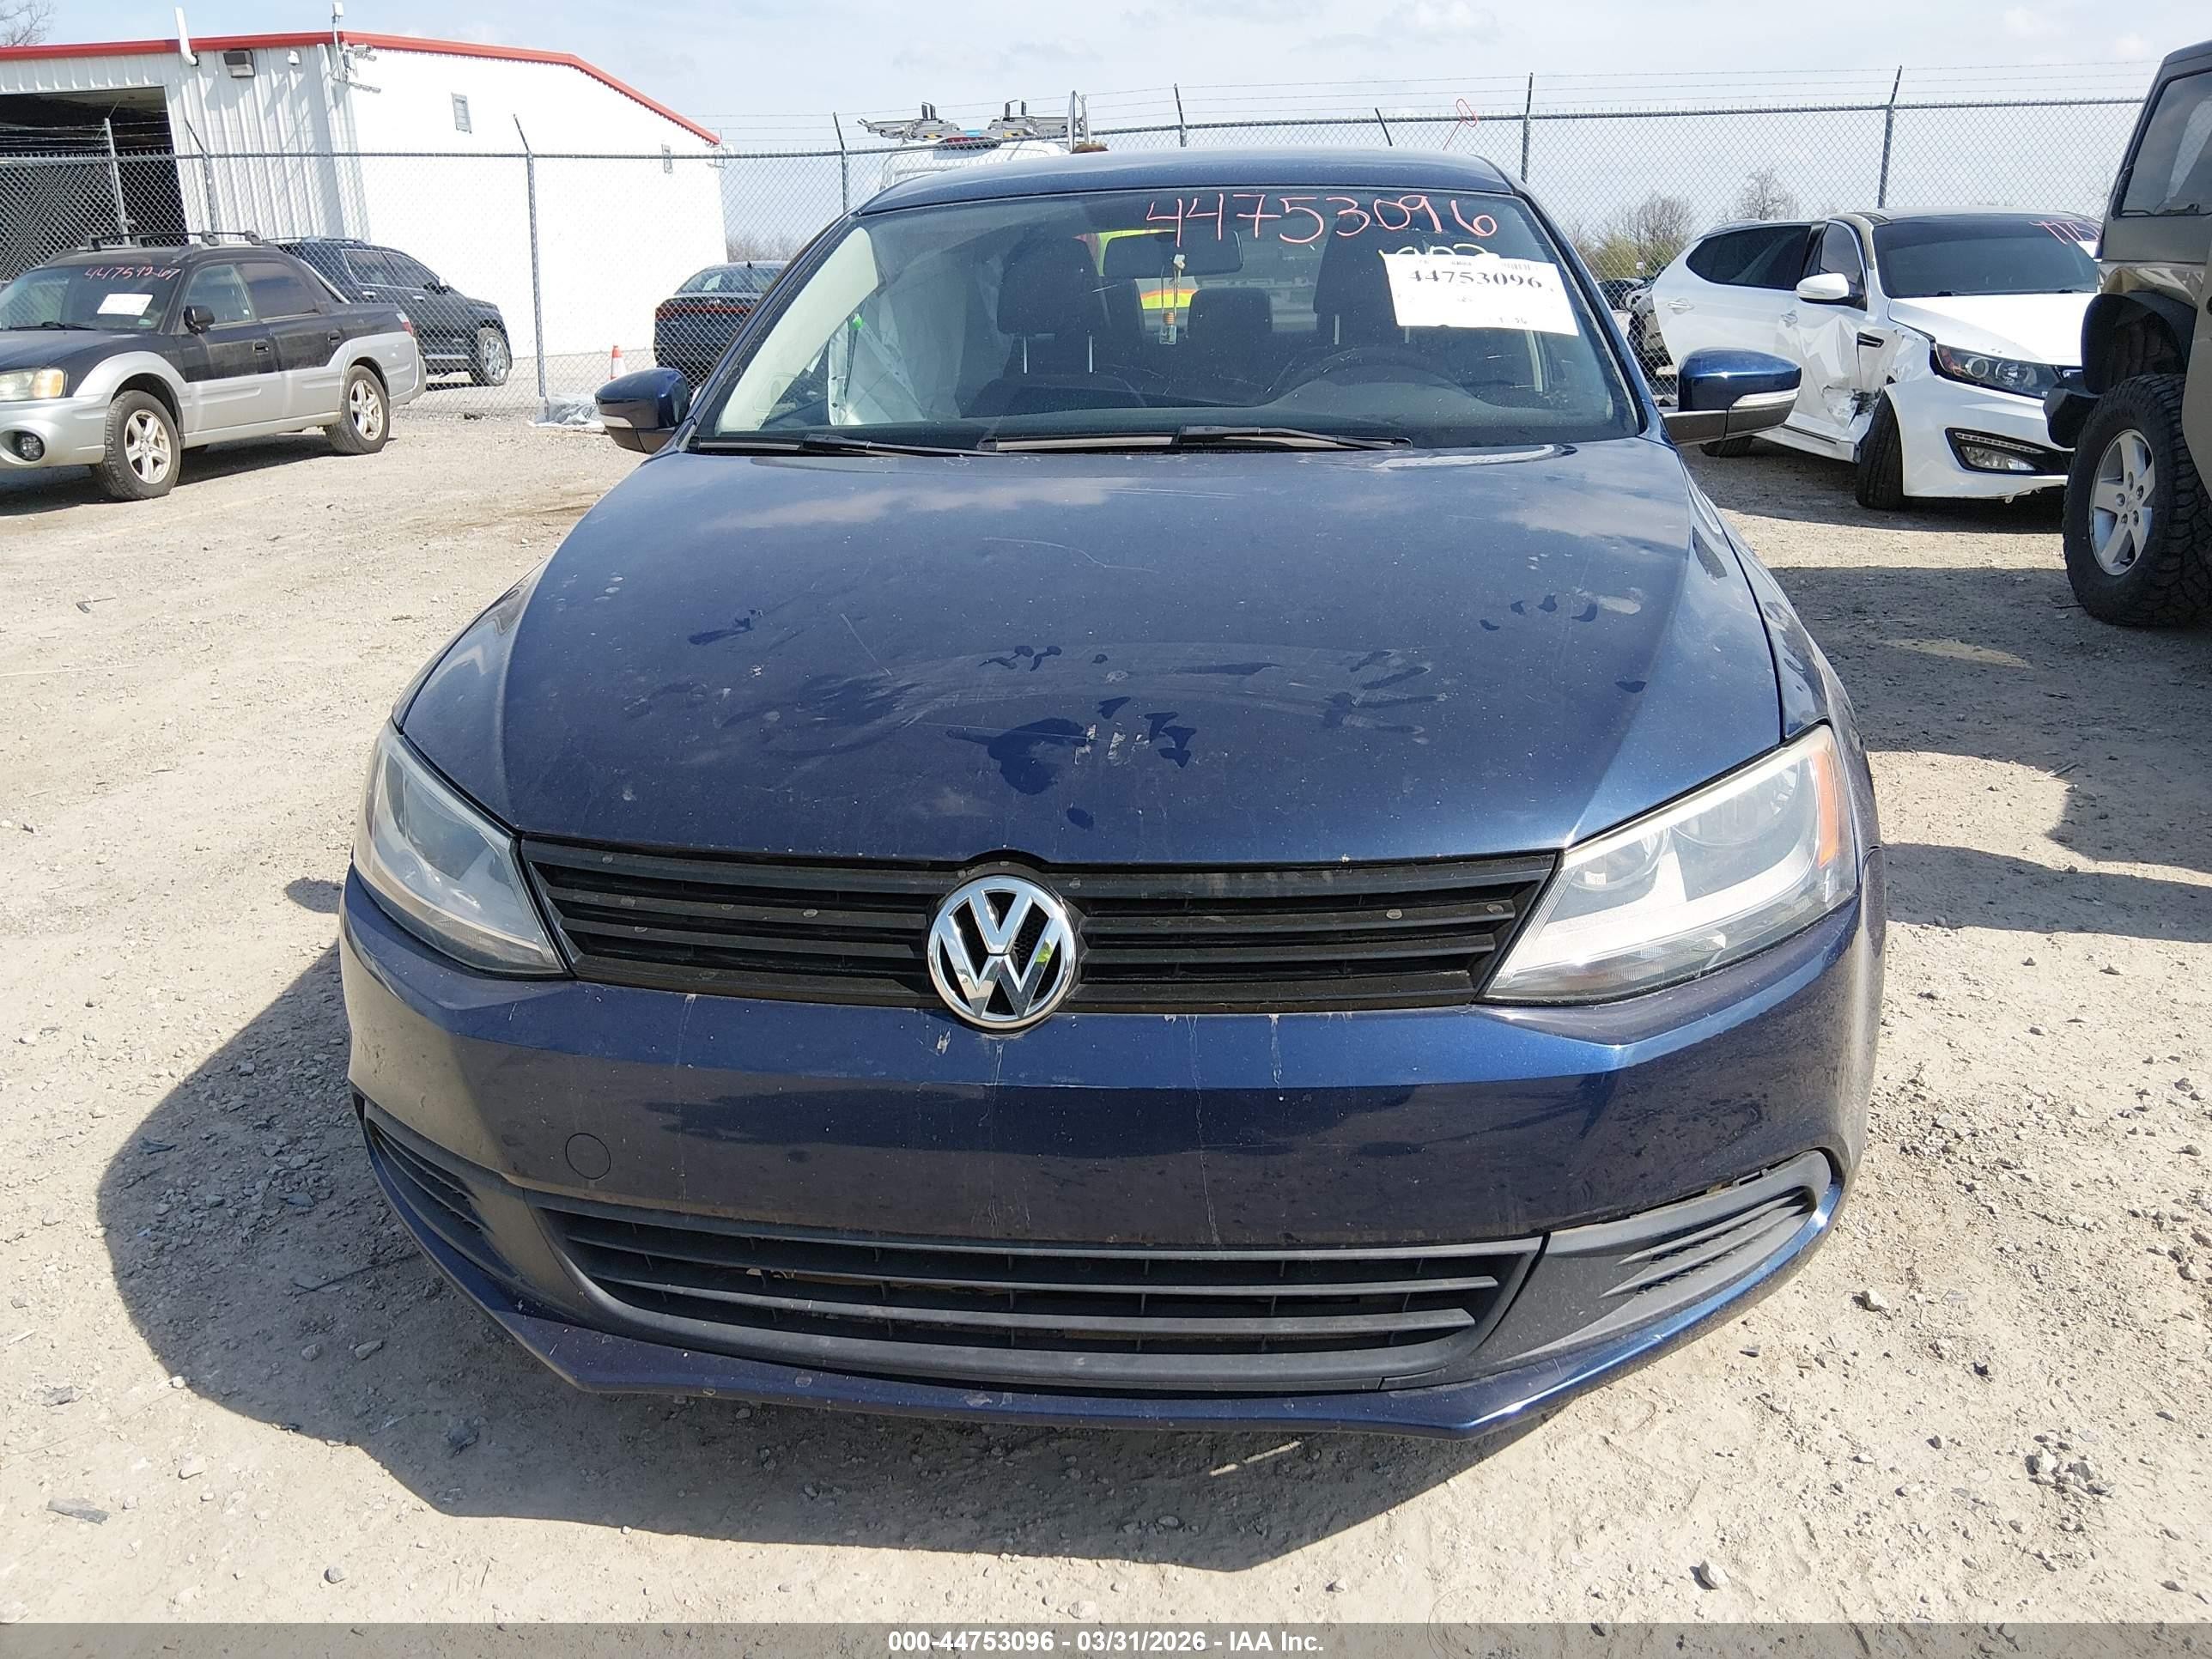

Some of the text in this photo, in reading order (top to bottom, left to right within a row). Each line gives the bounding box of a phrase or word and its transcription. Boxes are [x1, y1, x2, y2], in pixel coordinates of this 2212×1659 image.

[1146, 194, 1498, 247] 44753096
[1408, 268, 1543, 289] 44753096
[932, 881, 1073, 1025] VW
